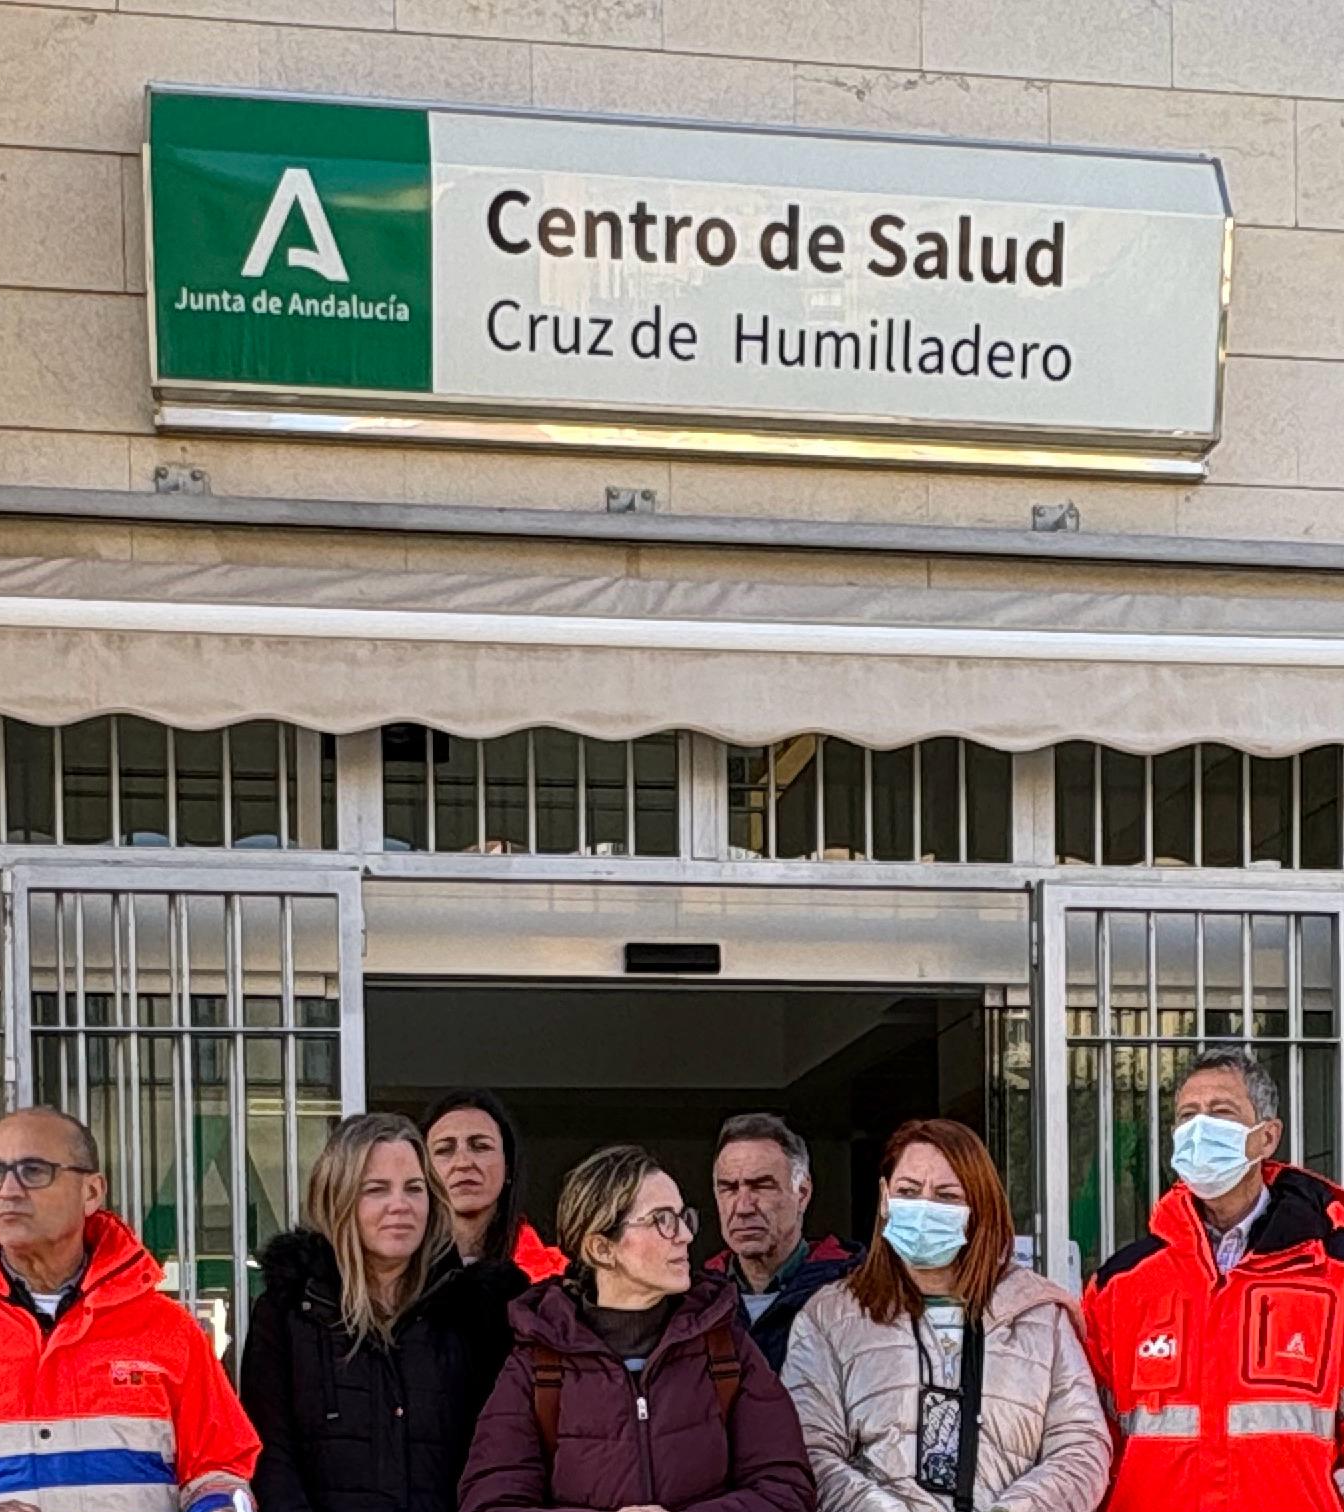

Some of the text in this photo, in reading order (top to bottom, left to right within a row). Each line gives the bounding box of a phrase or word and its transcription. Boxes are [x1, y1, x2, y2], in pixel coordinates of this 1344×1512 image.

[488, 191, 1064, 287] Centro de Salud
[174, 286, 410, 322] Junta de Andalucía
[487, 300, 1072, 383] Cruz de Humilladero
